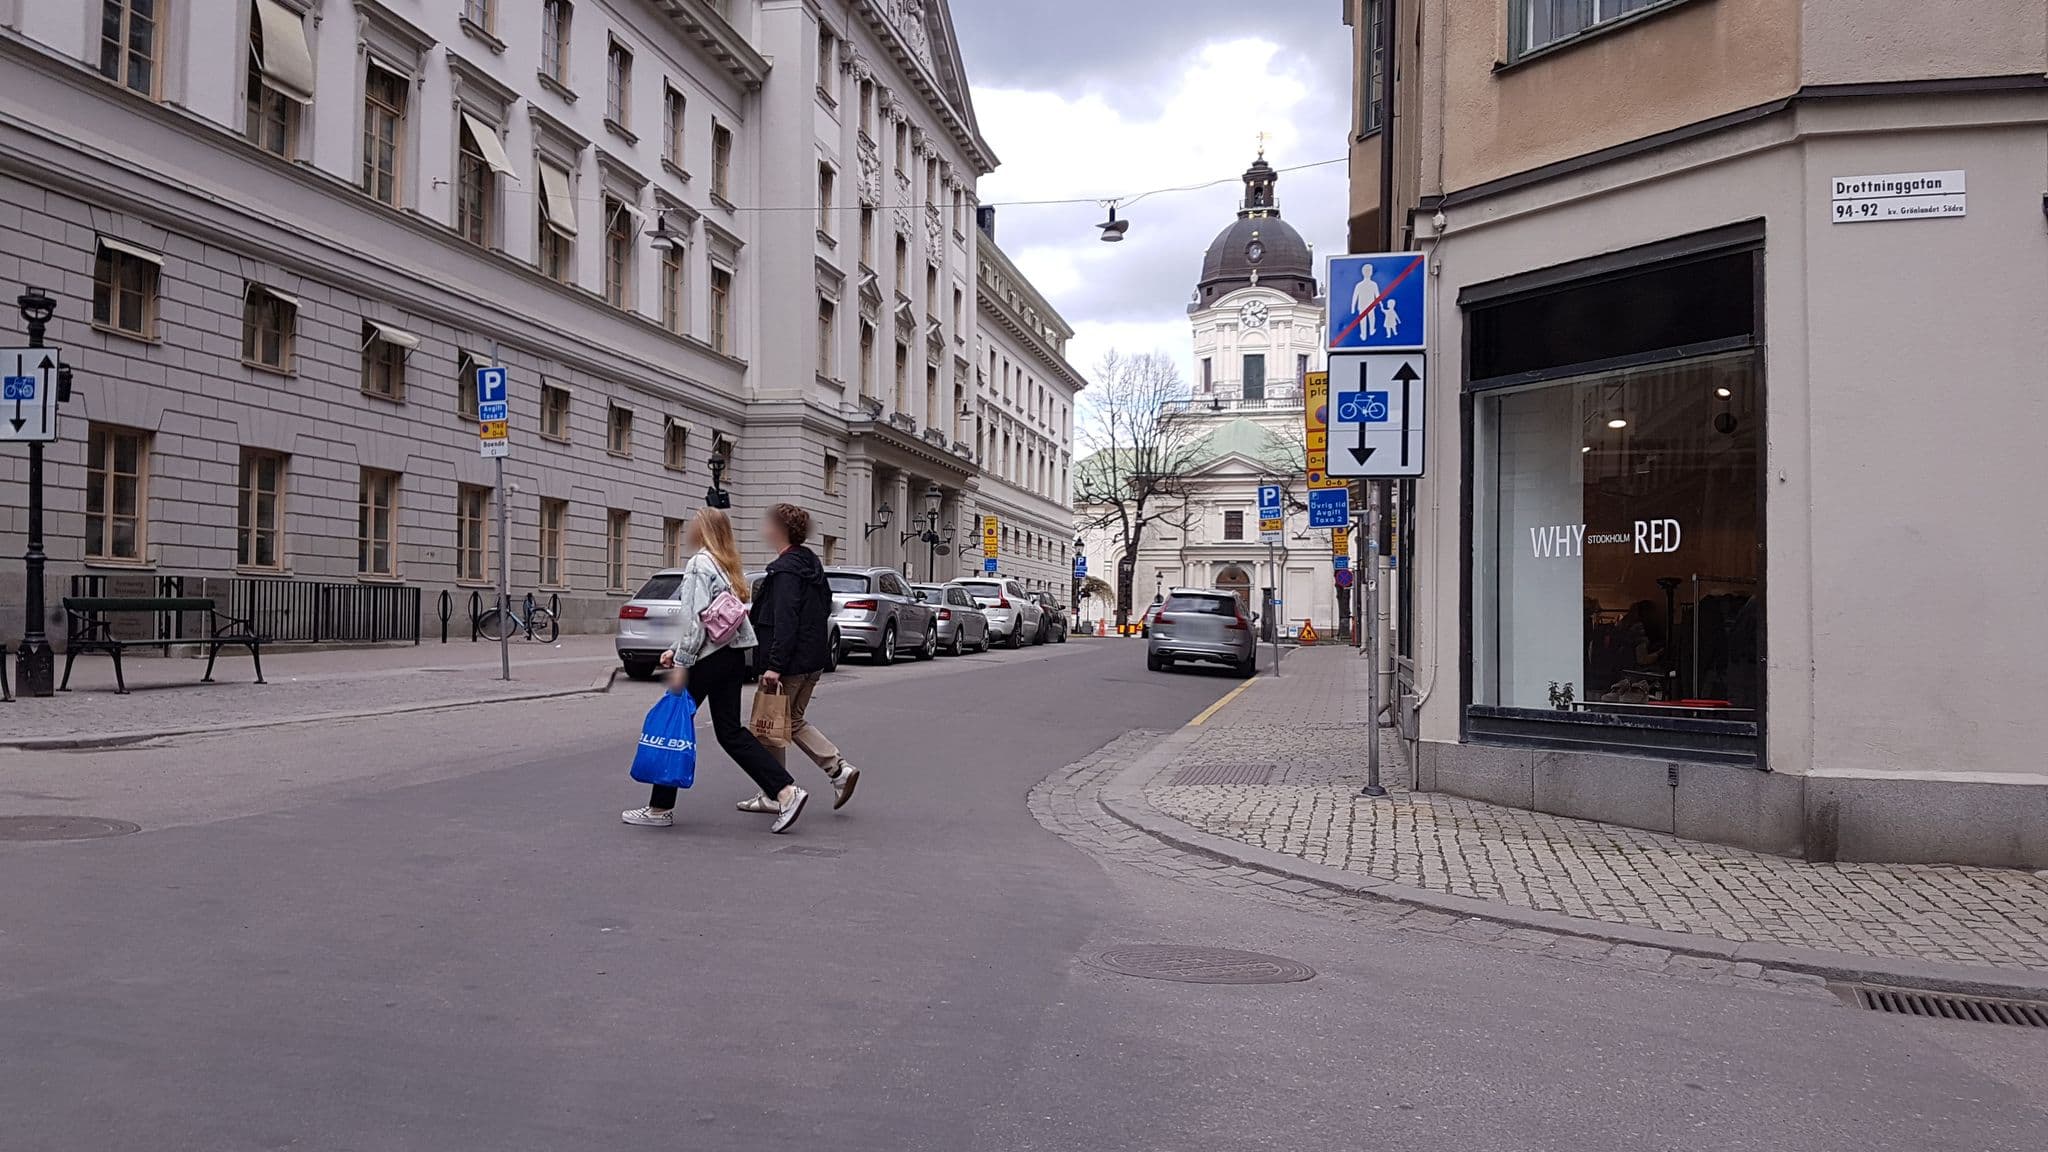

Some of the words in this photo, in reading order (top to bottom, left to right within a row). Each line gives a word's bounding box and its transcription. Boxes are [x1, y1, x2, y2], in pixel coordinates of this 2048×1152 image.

[1836, 179, 1942, 195] Drottninggatan
[1836, 203, 1878, 217] 94-92
[1943, 204, 1964, 213] Södra
[485, 371, 501, 400] P
[1263, 488, 1276, 506] P
[1530, 524, 1586, 558] WHY
[1587, 534, 1631, 545] STOCKHOLM
[1634, 519, 1681, 554] RED
[667, 739, 693, 750] BOX
